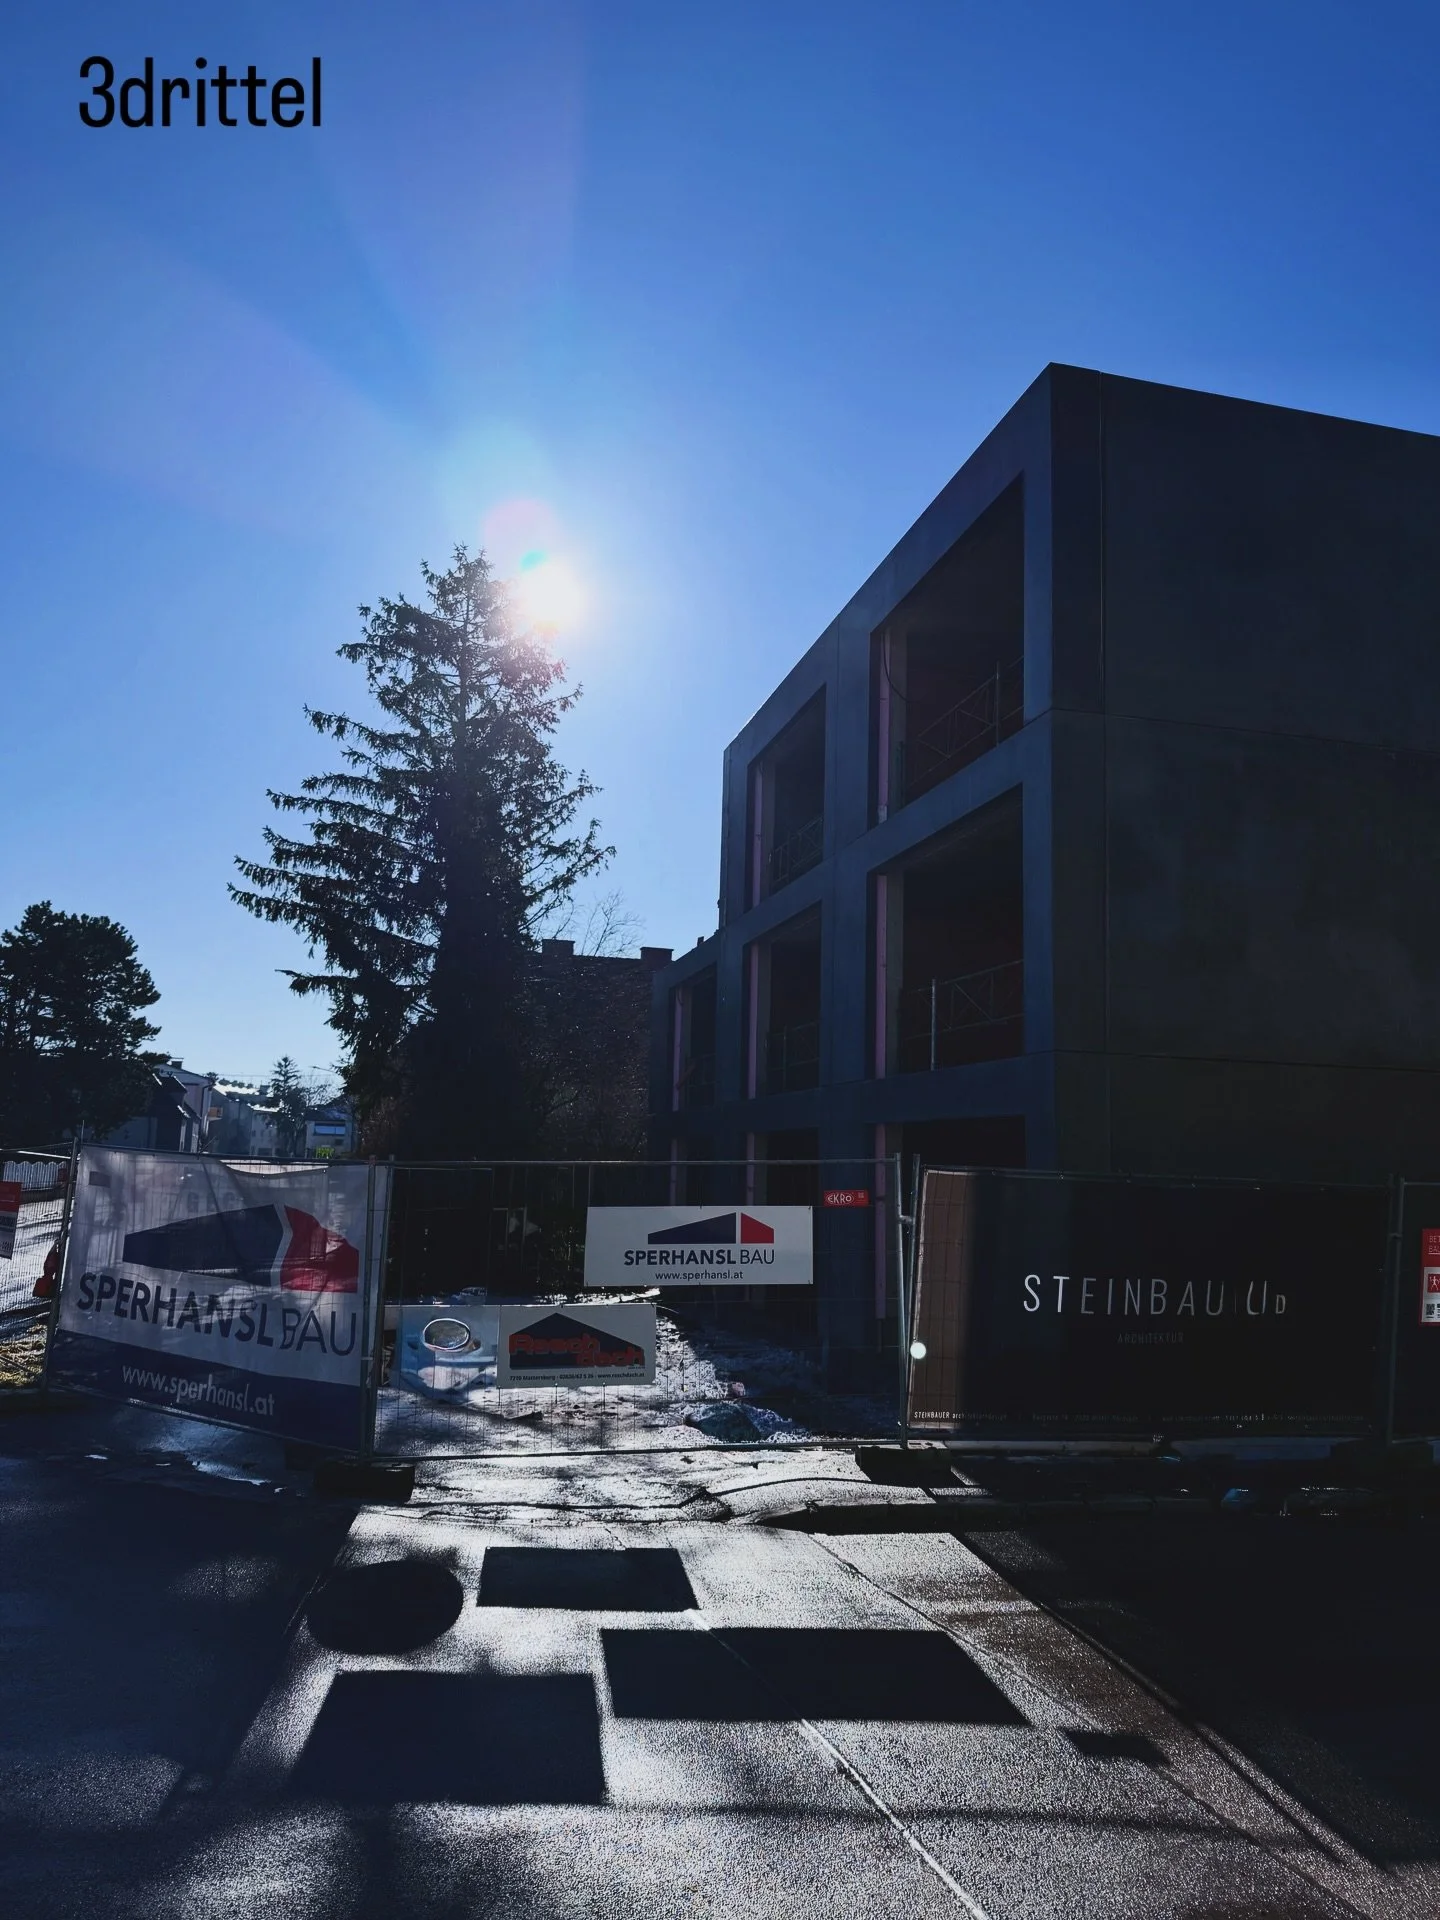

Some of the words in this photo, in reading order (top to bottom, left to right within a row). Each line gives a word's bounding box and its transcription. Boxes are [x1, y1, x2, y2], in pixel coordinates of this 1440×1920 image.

[623, 1249, 737, 1266] SPERHANSL
[739, 1249, 775, 1265] BAU
[655, 1269, 744, 1281] www.sperhansl.at
[121, 1364, 276, 1417] www.sperhansl.at
